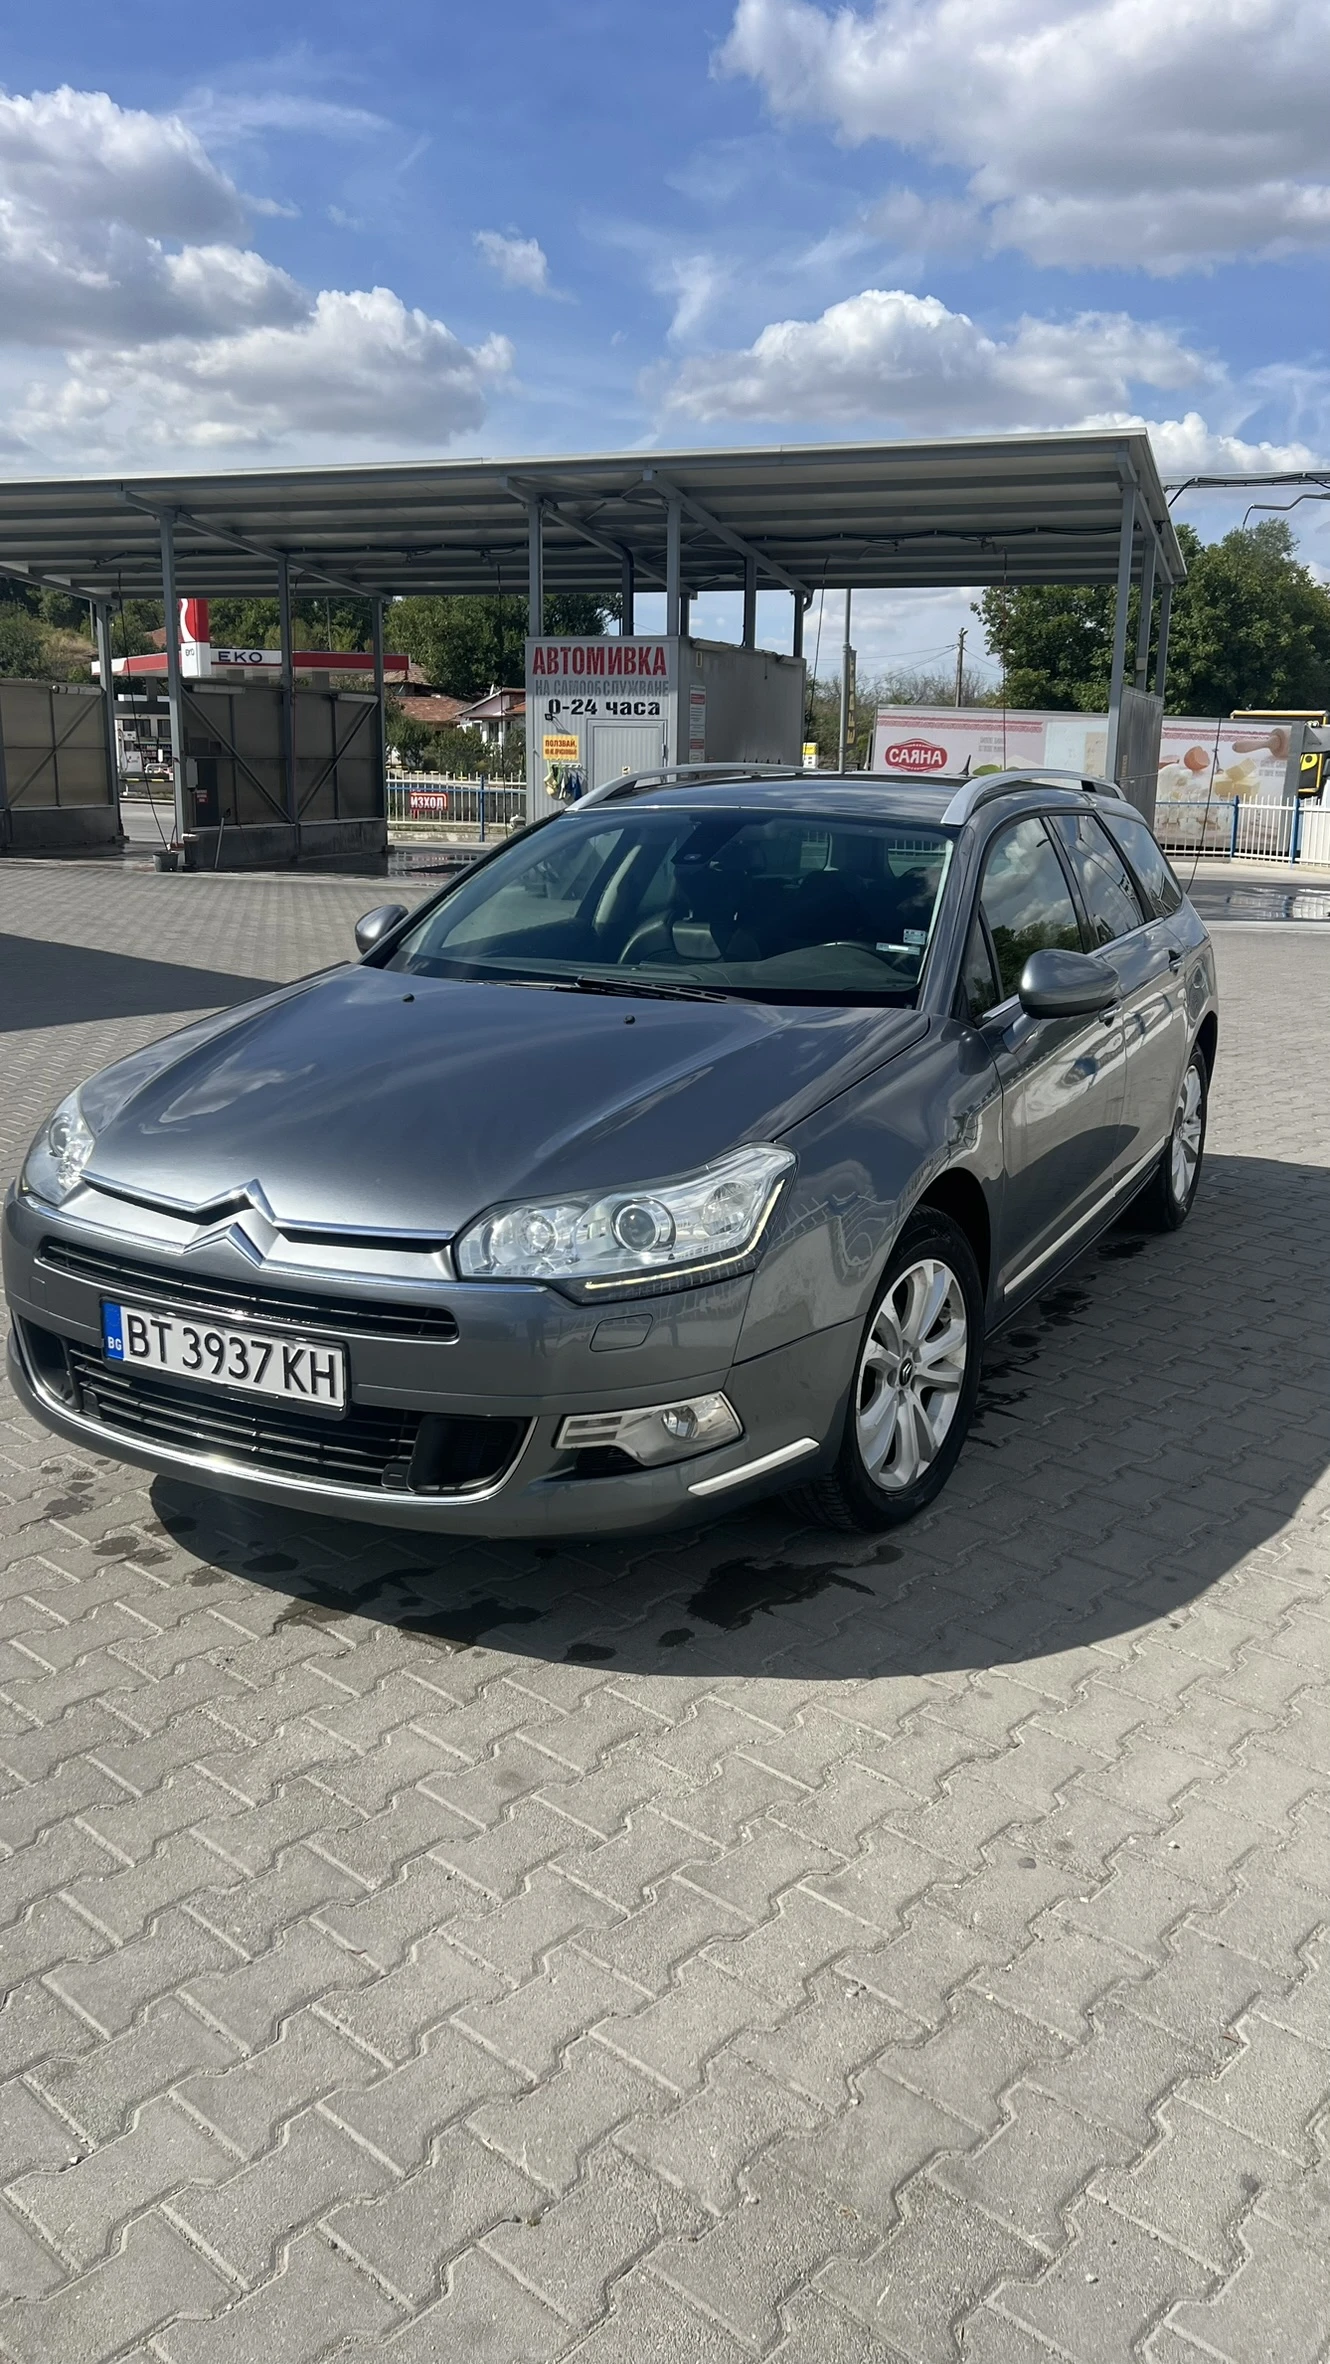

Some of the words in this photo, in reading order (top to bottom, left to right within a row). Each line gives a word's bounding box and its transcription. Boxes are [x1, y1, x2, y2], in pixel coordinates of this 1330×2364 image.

[218, 651, 263, 663] EKO
[532, 646, 667, 676] АВТОМИВКА
[535, 680, 550, 696] НА
[553, 680, 669, 697] САМООБСЛУЖВАНЕ
[548, 698, 598, 715] 0-24
[605, 701, 660, 716] часа
[889, 748, 942, 765] САЯНА
[410, 796, 444, 810] ИЗХОД
[107, 1336, 122, 1351] BG
[127, 1313, 172, 1363] BT
[182, 1327, 273, 1384] 3937
[283, 1345, 337, 1399] KH
